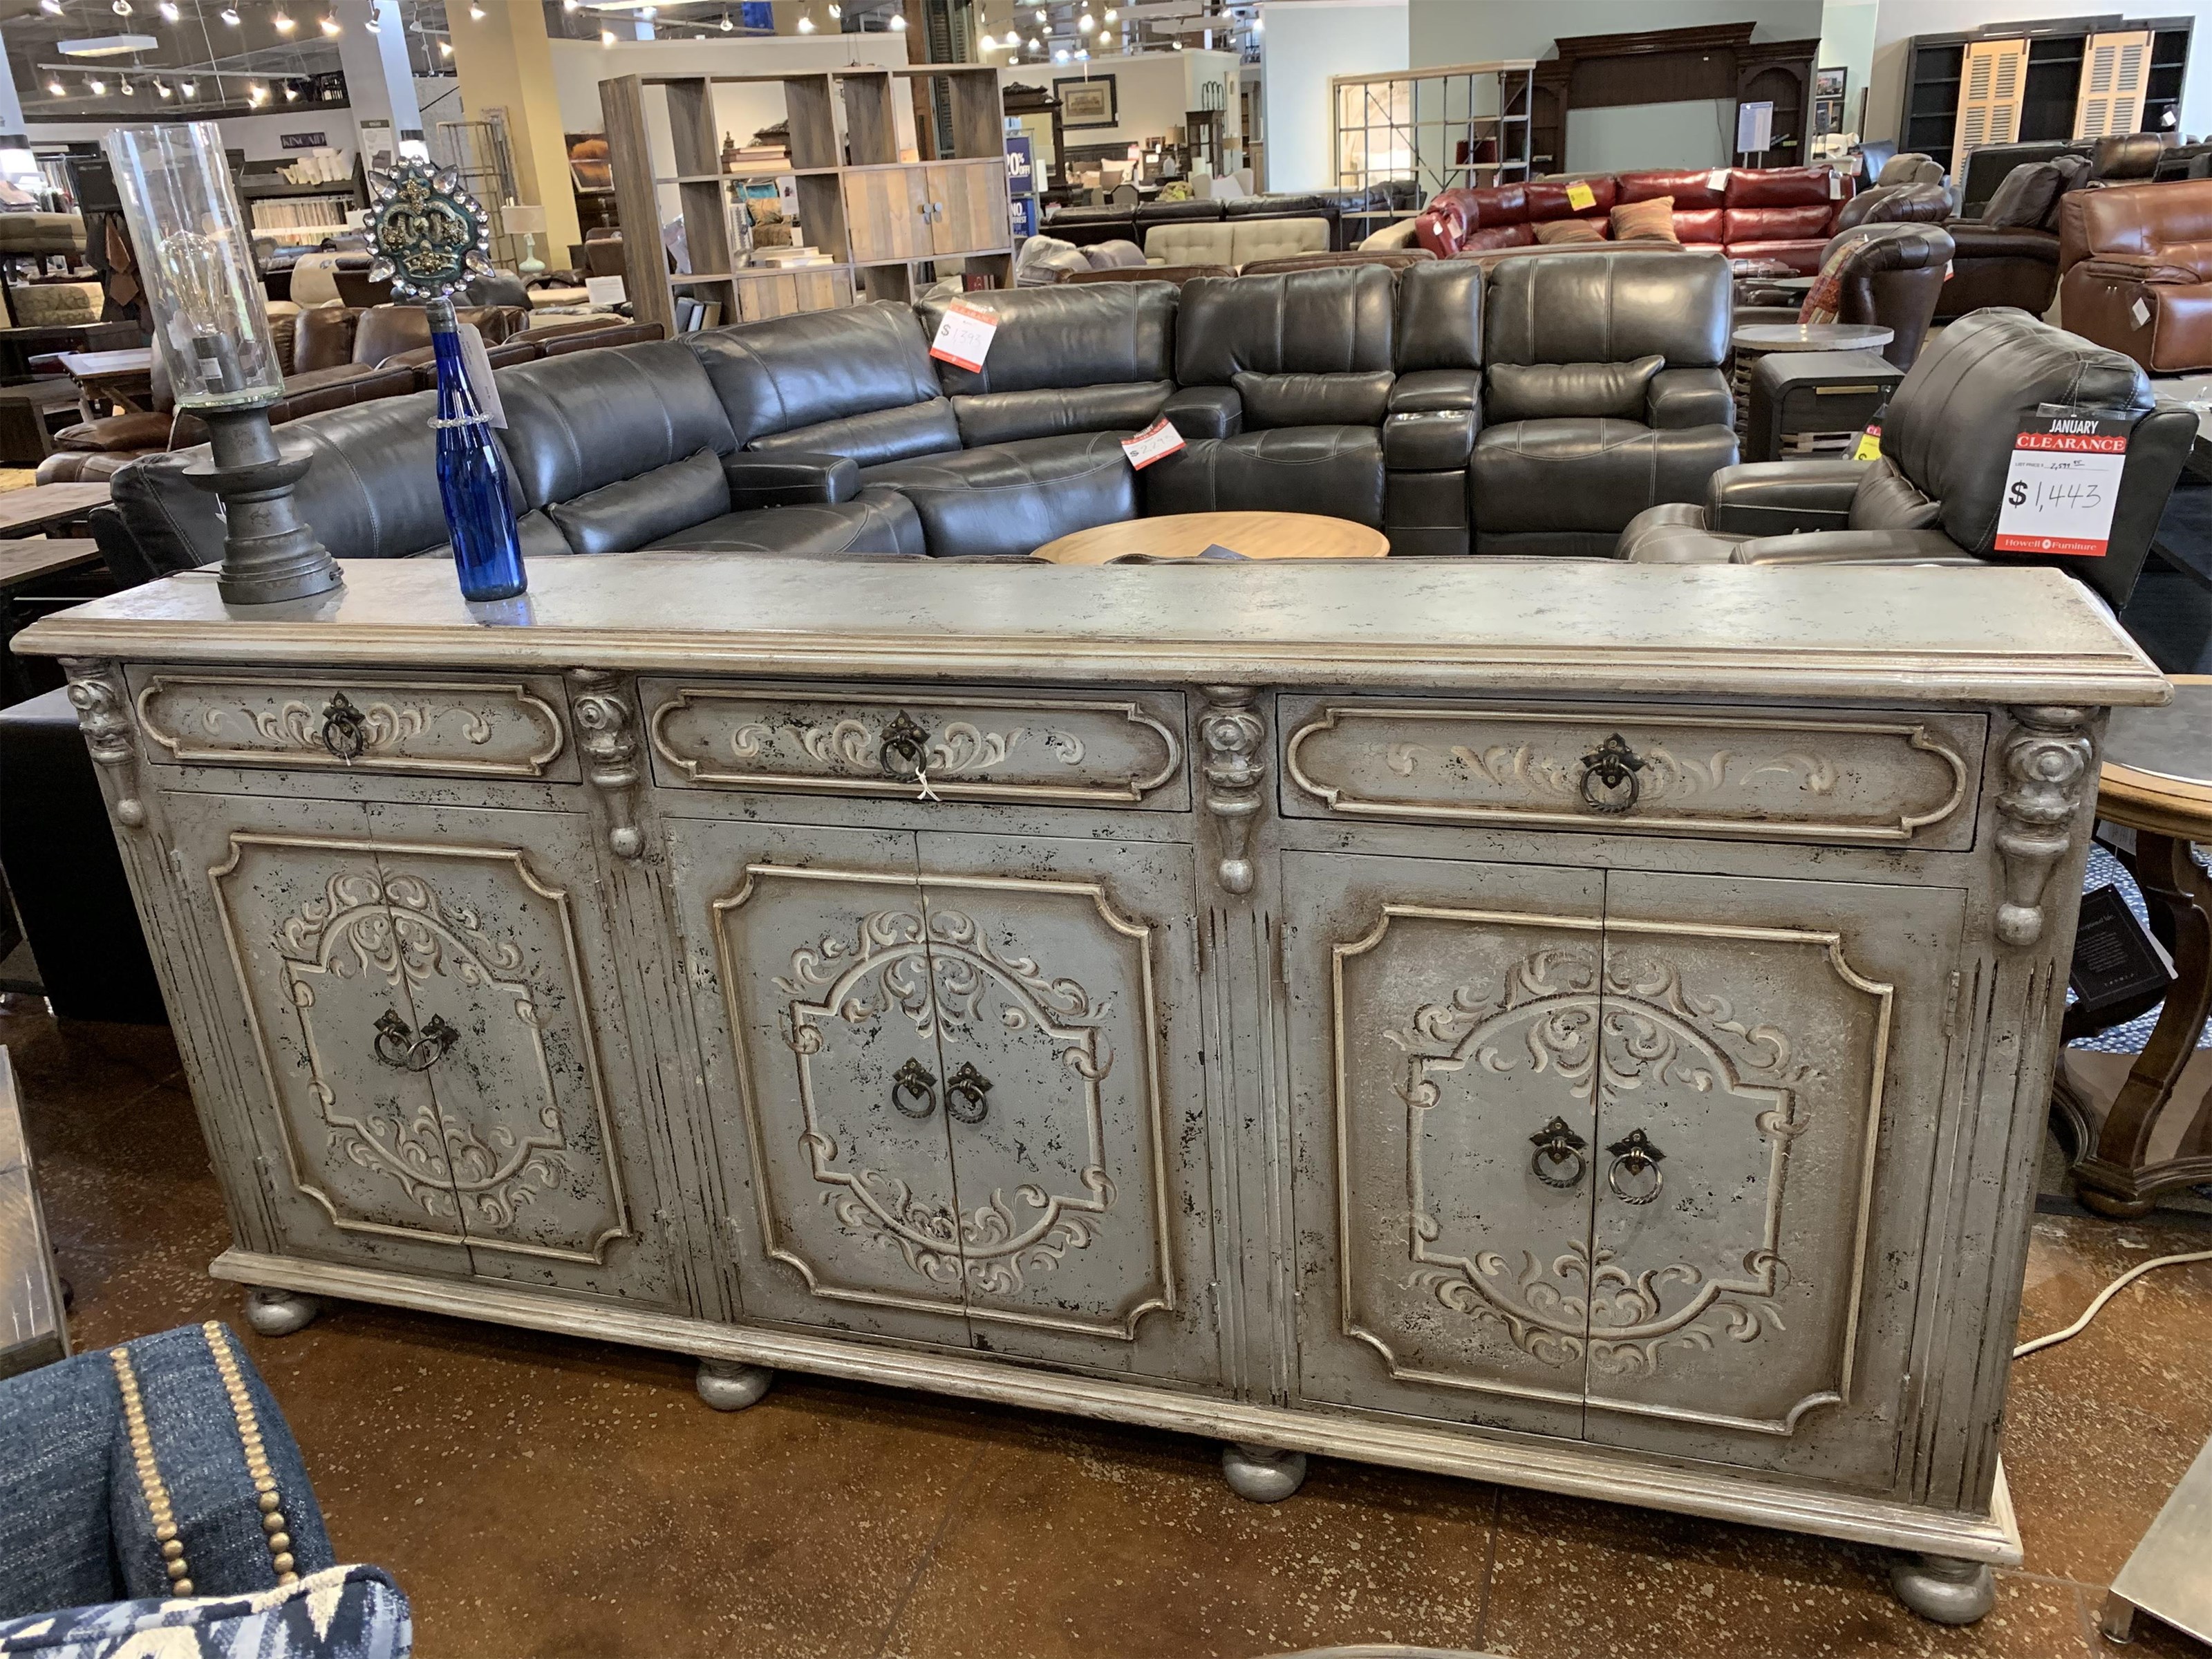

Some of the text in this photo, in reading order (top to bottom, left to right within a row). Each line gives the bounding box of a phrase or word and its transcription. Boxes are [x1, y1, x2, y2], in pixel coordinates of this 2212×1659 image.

[2049, 419, 2099, 434] JANUARY
[2016, 435, 2126, 451] CLEARANCE
[2005, 539, 2097, 551] Howell Furniture
